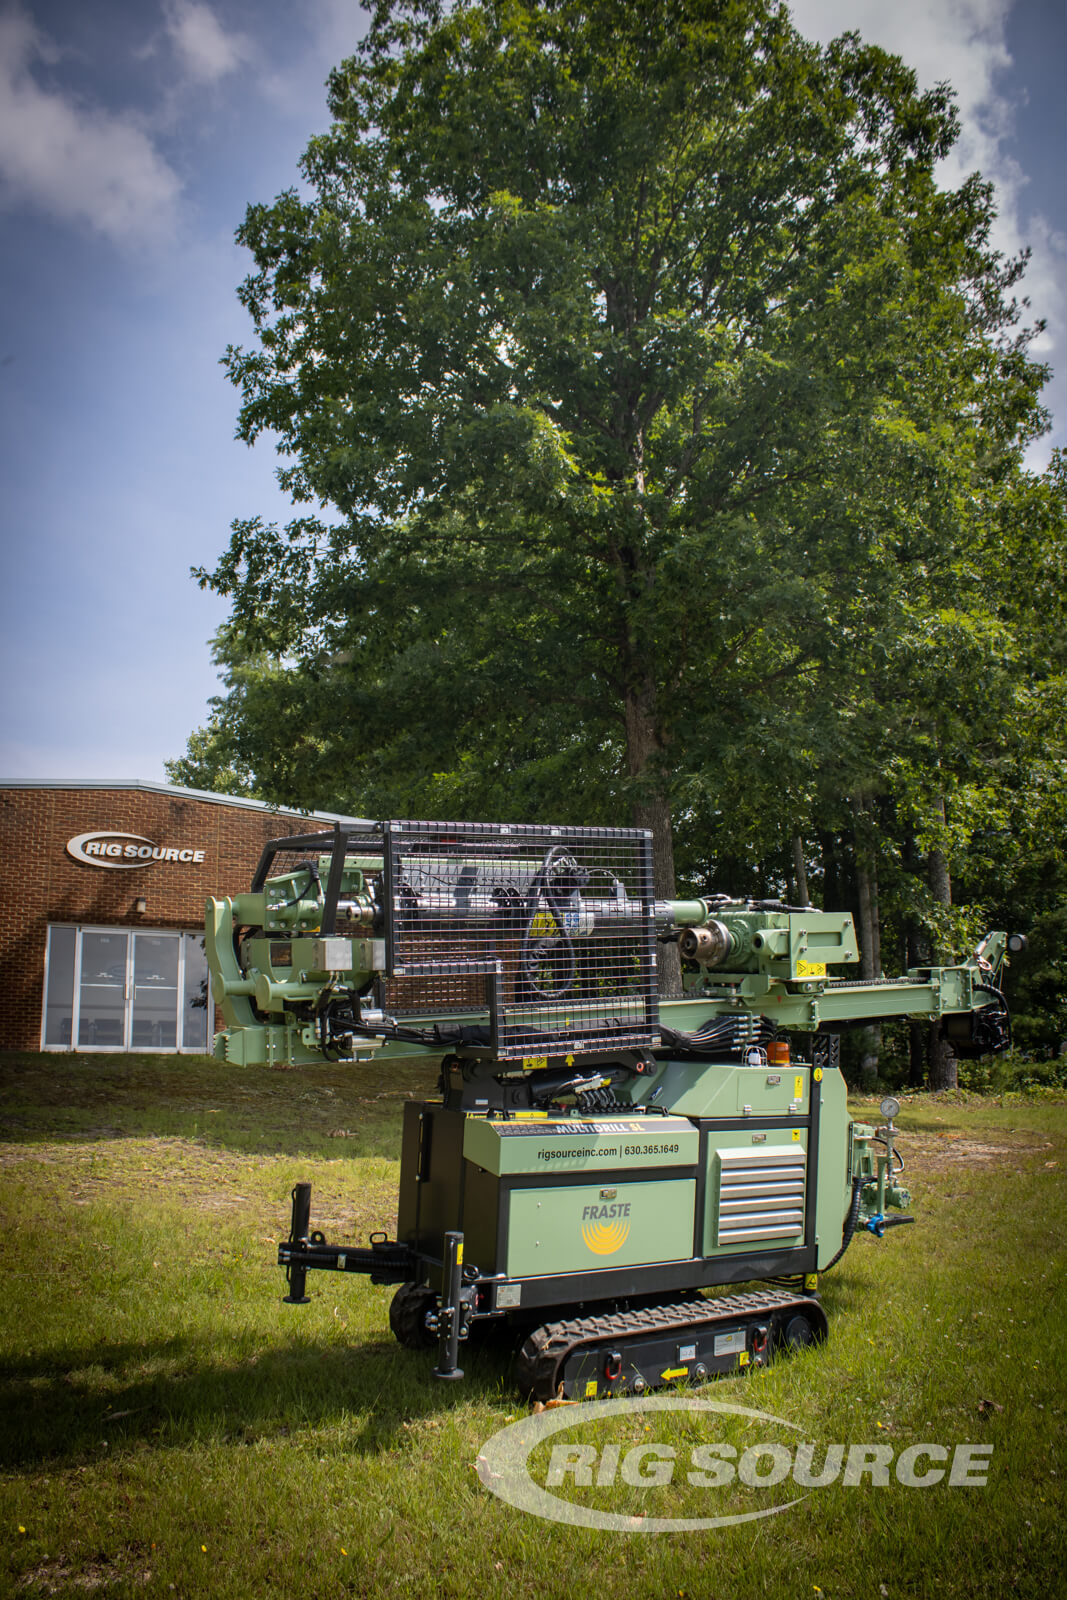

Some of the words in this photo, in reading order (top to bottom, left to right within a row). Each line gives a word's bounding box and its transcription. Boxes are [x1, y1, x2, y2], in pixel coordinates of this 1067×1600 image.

[85, 842, 122, 857] RIG
[123, 845, 205, 863] SOURCE
[555, 1122, 630, 1134] MULTIDRILL
[630, 1123, 646, 1132] SL
[537, 1146, 617, 1161] rigsourceinc.com
[624, 1144, 679, 1156] 630.365.1649
[582, 1202, 631, 1220] FRASTE
